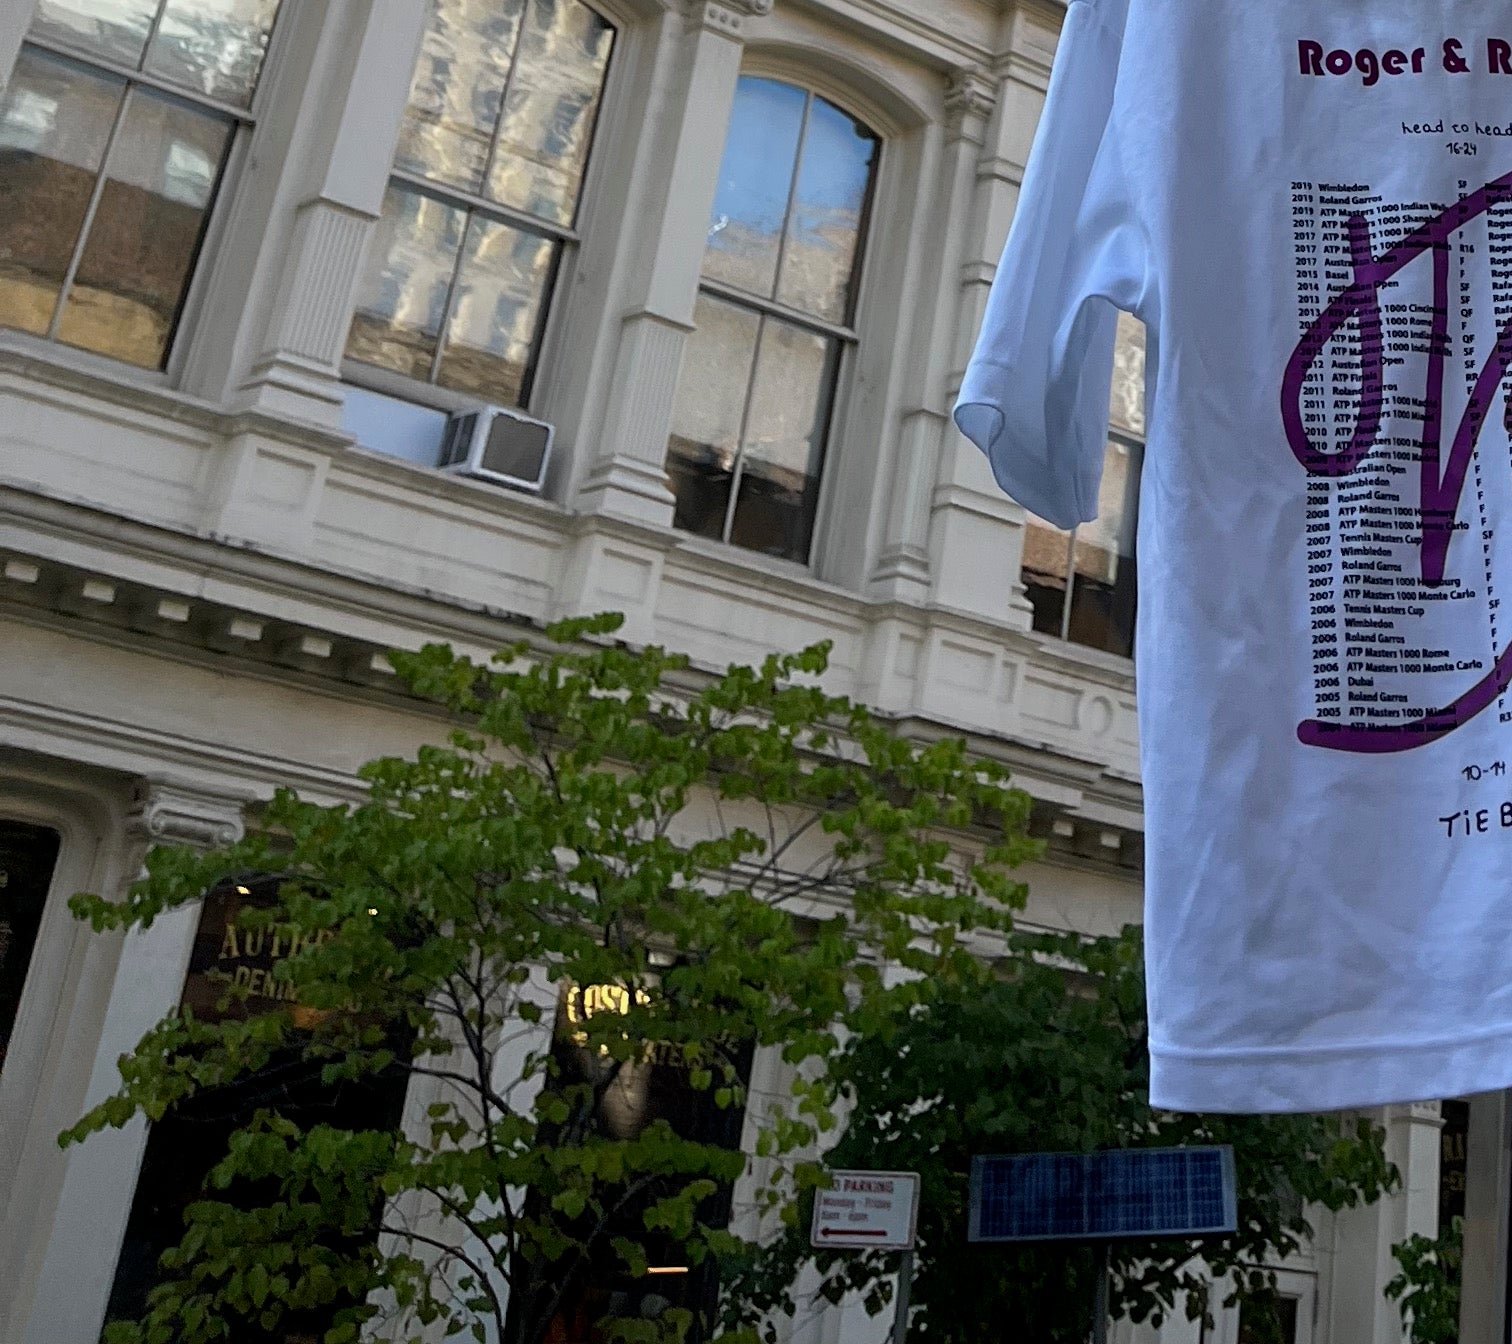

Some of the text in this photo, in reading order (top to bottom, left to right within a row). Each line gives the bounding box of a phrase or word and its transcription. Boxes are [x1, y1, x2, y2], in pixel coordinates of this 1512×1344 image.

[1298, 39, 1425, 86] Roger
[1443, 38, 1470, 73] &
[1402, 119, 1512, 136] head to head
[1446, 143, 1476, 155] 16-24
[1319, 184, 1369, 192] Wimbledon
[1320, 196, 1350, 204] Roland
[1352, 196, 1382, 204] Garros
[1377, 205, 1399, 213] 1000
[1401, 203, 1429, 211] Indian
[1487, 207, 1512, 217] Roger
[1326, 271, 1348, 279] Basel
[1337, 477, 1390, 490] Wimbledon
[1338, 491, 1372, 503] Roland
[1375, 491, 1399, 502] Garros
[1339, 507, 1356, 516] ATP
[1359, 505, 1392, 516] Masters
[1394, 508, 1412, 516] 1000
[1340, 520, 1357, 529] ATP
[1360, 519, 1393, 529] Masters
[1395, 521, 1414, 529] 1000
[1307, 536, 1330, 546] 2007
[1373, 534, 1403, 544] Masters
[1405, 535, 1422, 545] Cup
[1308, 548, 1392, 560] 2007 Wimbledon
[1308, 561, 1401, 573] 2007 Roland Garros
[1309, 575, 1415, 587] 2007 ATP Masters 1000
[1310, 588, 1475, 601] 2007 ATP Masters 1000 Monte Carlo
[1344, 604, 1371, 614] Tennis
[1373, 605, 1405, 615] Masters
[1408, 606, 1424, 617] Cup
[1312, 618, 1393, 629] 2006 Wimbledon
[1345, 633, 1376, 643] Roland
[1378, 634, 1405, 644] Garros
[1313, 648, 1338, 659] 2006
[1346, 648, 1363, 657] ATP
[1365, 648, 1397, 658] Masters
[1400, 649, 1420, 658] 1000
[1313, 663, 1339, 673] 2006
[1347, 662, 1363, 672] ATP
[1366, 663, 1398, 673] Masters
[1400, 663, 1421, 673] 1000
[1423, 663, 1454, 672] Monte
[1457, 660, 1482, 670] Carlo
[1315, 677, 1339, 688] 2006
[1348, 677, 1373, 687] Dubai
[1315, 692, 1340, 703] 2005
[1349, 692, 1377, 701] Roland
[1380, 692, 1407, 702] Garros
[1349, 707, 1365, 717] ATP
[1368, 707, 1400, 717] Masters
[1403, 708, 1423, 717] 1000
[1461, 761, 1505, 780] 10-14
